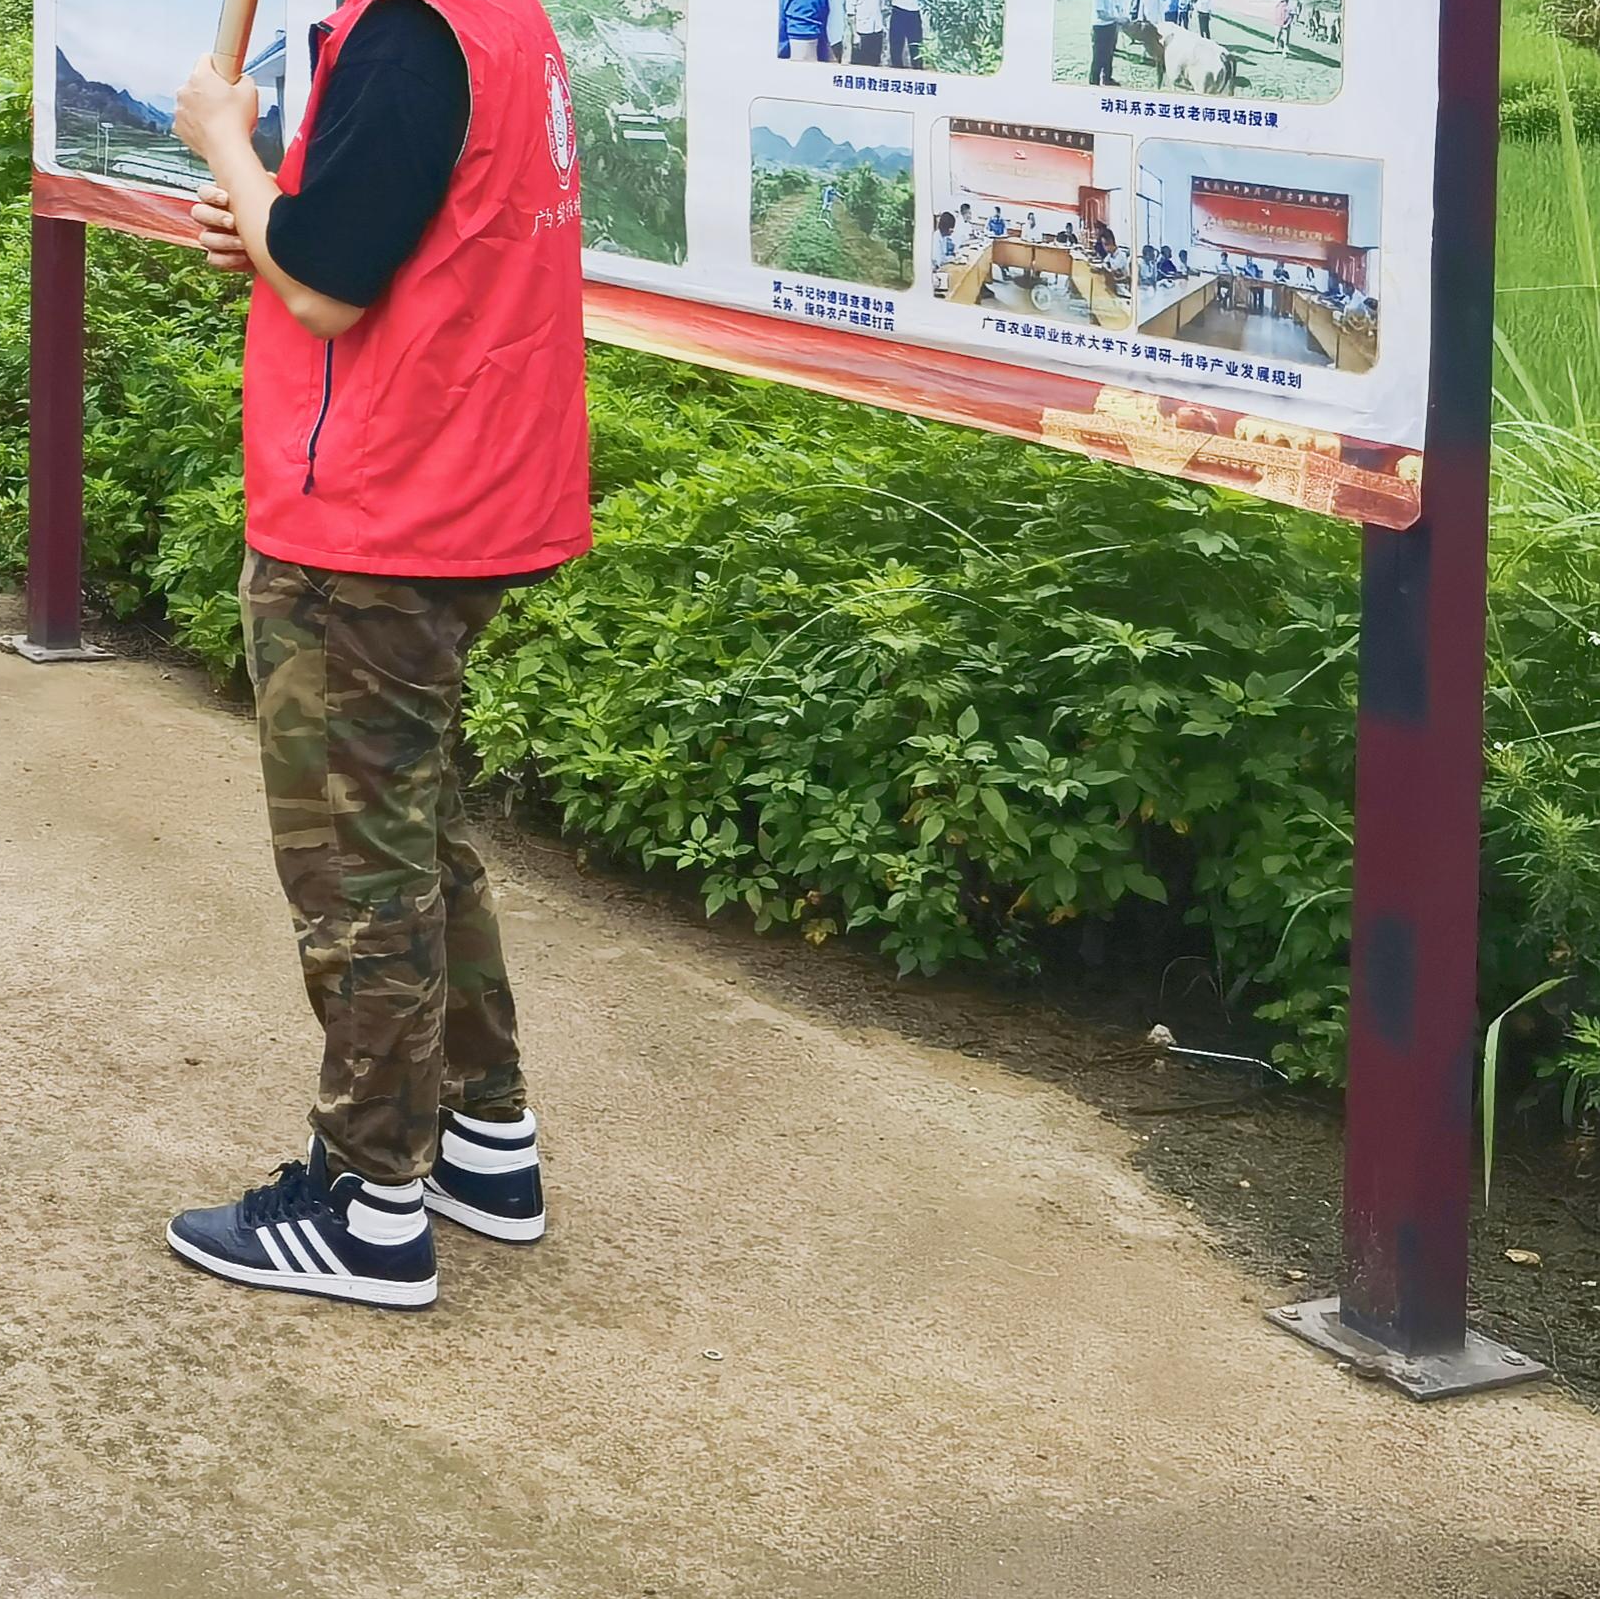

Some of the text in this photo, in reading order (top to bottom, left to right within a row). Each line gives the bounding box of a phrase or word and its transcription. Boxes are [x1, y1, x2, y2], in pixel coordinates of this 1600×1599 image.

[1100, 97, 1279, 128] 动科系苏亚权老师现场授课
[982, 316, 1302, 389] 广西农业职业技术大学下乡调研-指导产业发展规划
